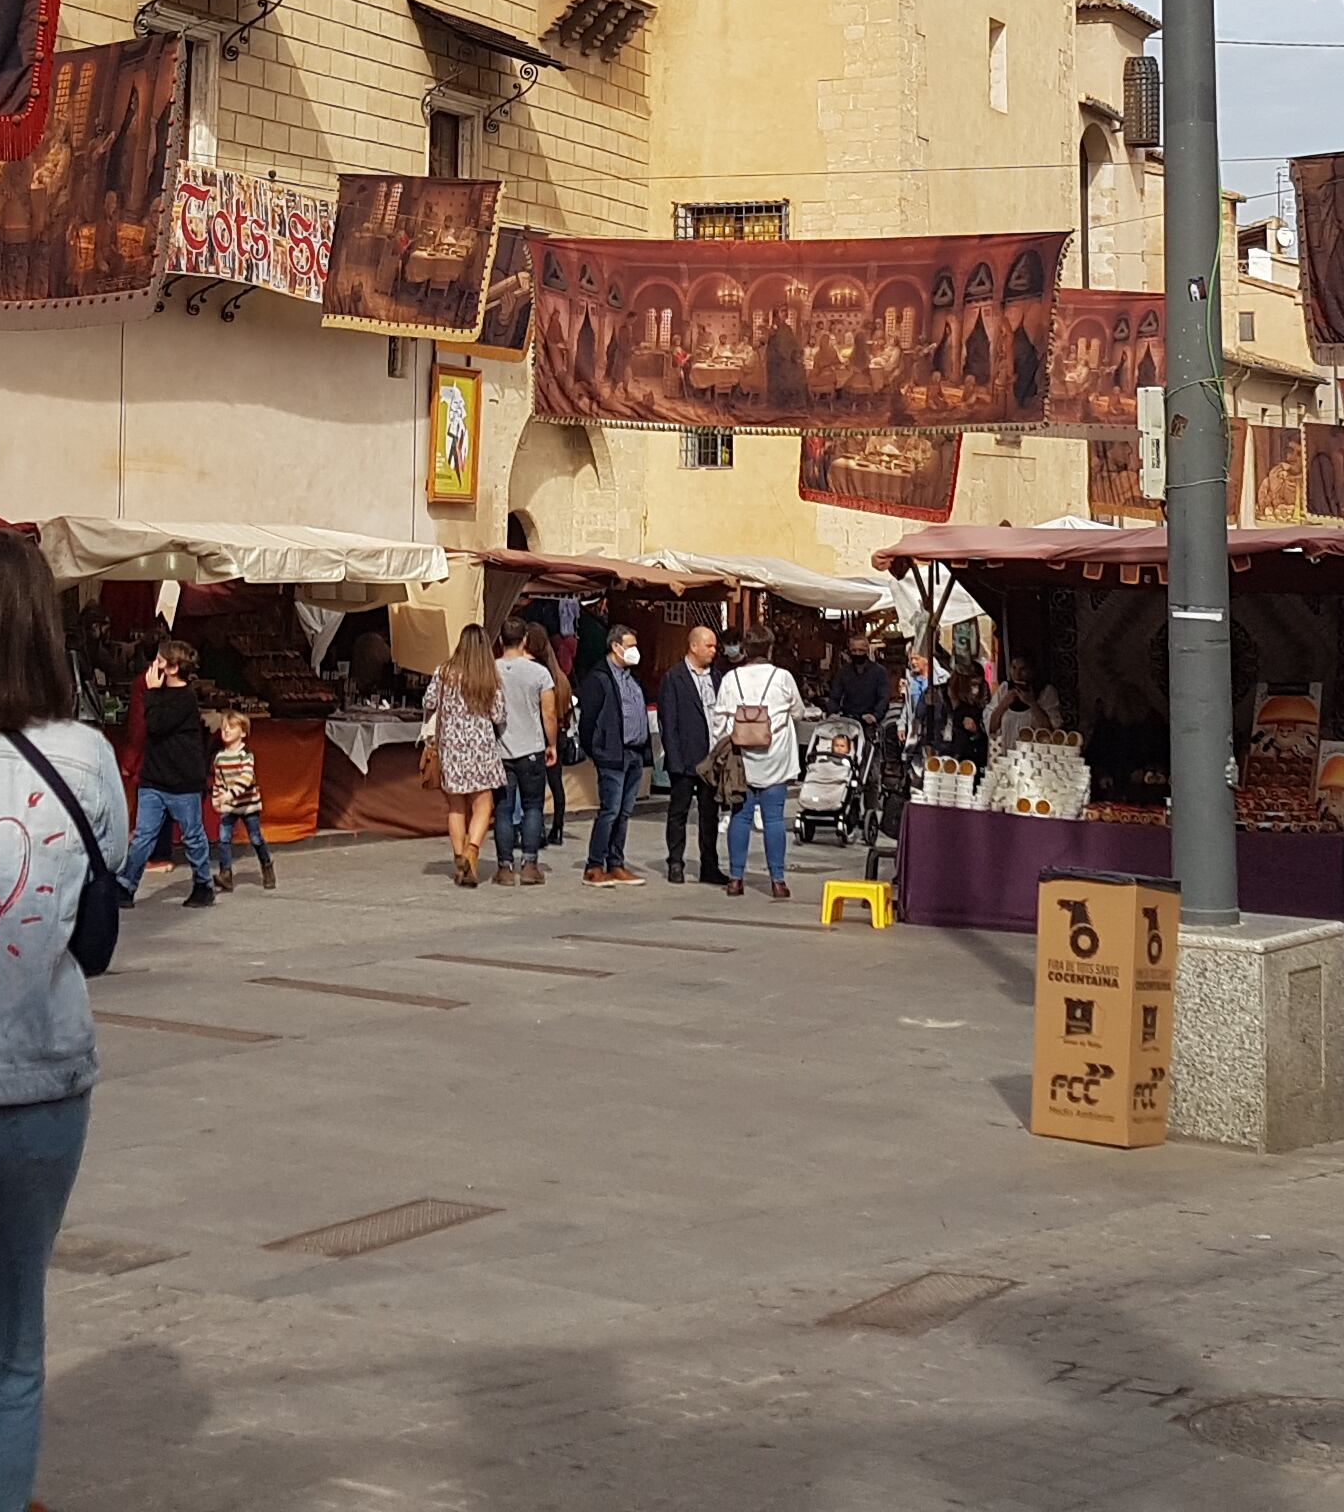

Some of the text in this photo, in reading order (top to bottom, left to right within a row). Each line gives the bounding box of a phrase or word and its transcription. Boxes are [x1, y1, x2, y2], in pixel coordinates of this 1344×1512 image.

[176, 181, 270, 262] Tots
[1048, 971, 1120, 989] COCENTAINA
[1050, 1073, 1102, 1106] FCC
